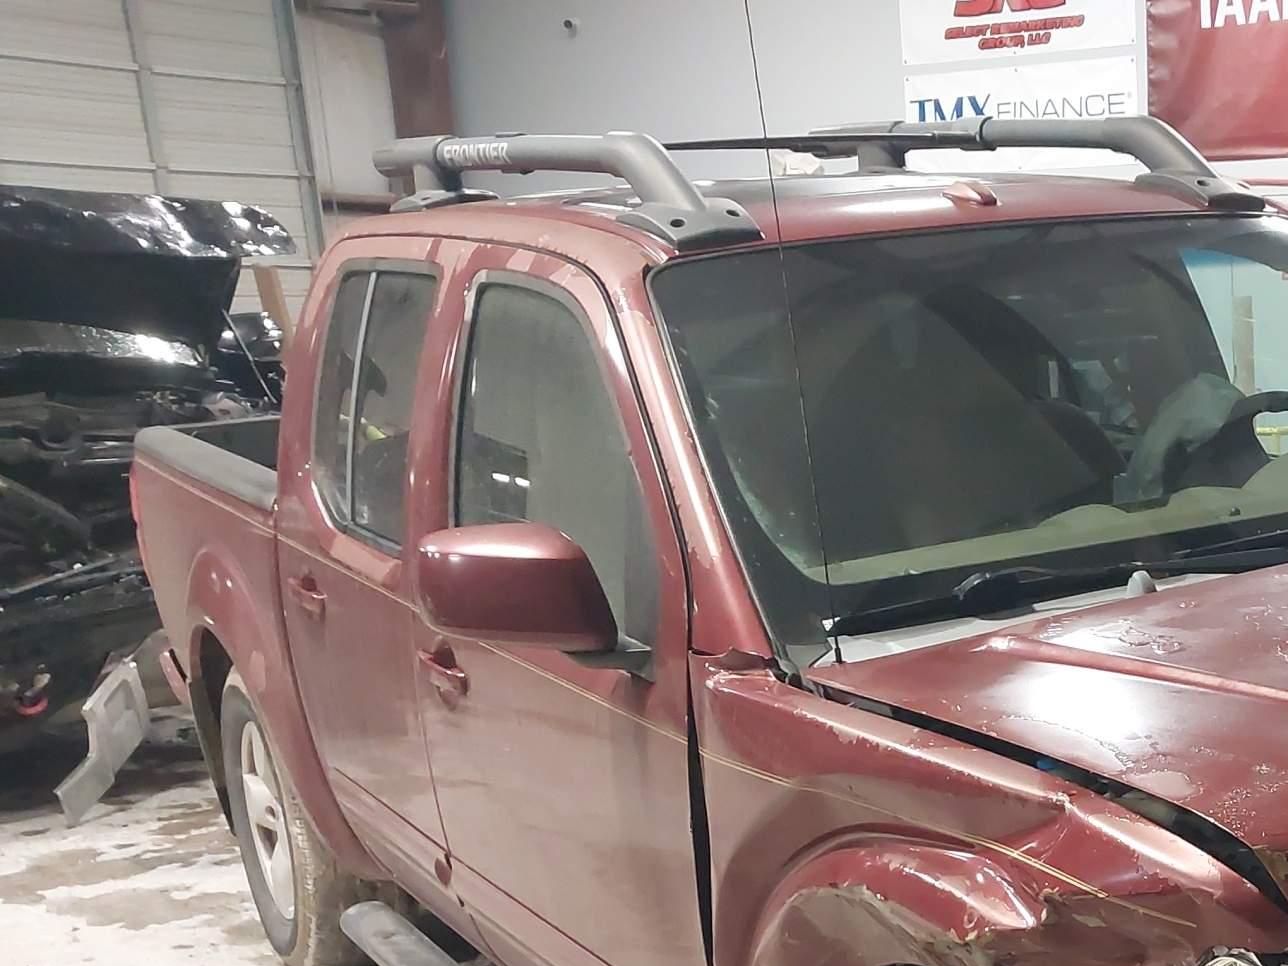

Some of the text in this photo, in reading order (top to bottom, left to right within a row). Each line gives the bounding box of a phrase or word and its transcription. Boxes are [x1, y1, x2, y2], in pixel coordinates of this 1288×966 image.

[910, 93, 1125, 121] TMX FINANCE
[444, 142, 512, 166] FRONTIER
